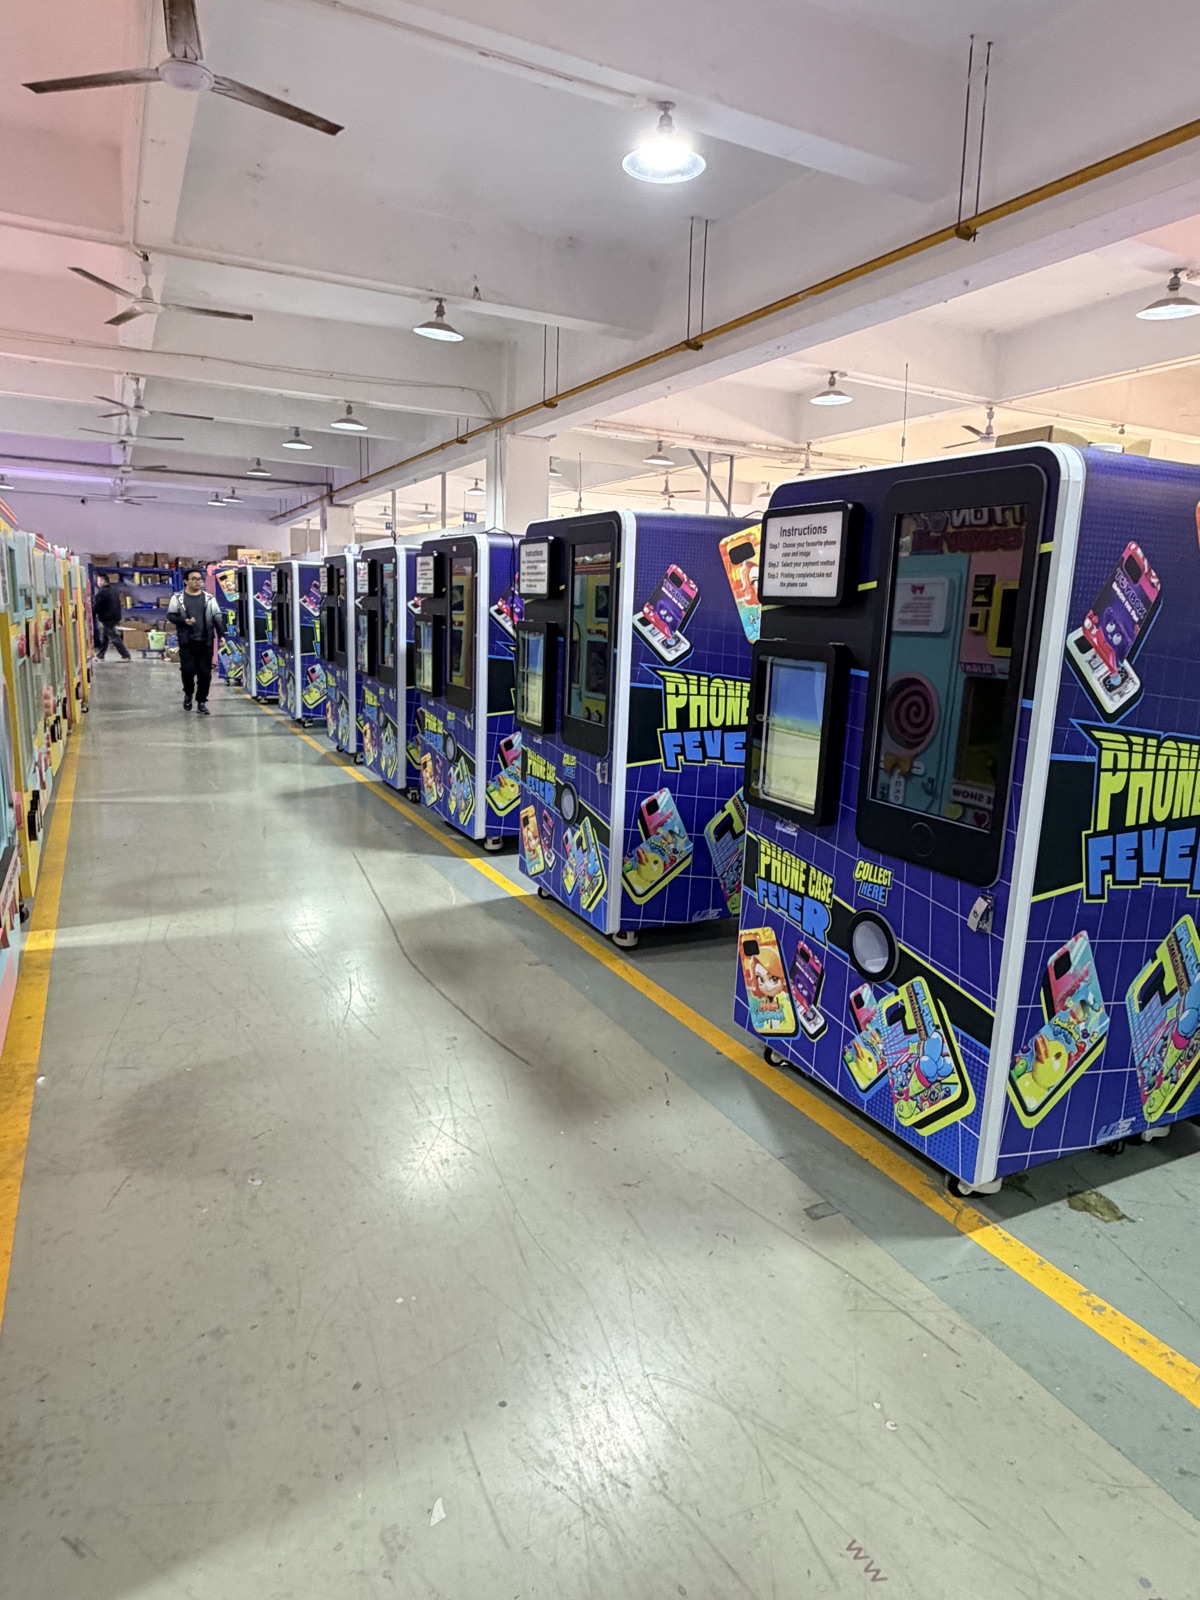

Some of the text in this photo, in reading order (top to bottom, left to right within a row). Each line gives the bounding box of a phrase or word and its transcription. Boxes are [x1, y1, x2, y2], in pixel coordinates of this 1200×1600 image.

[780, 524, 828, 537] Instructions
[769, 542, 780, 550] Step.1
[797, 541, 805, 549] your
[824, 539, 837, 548] phone
[799, 550, 811, 558] image
[768, 561, 779, 569] Step.2
[781, 560, 793, 568] Select
[794, 561, 802, 569] your
[802, 560, 820, 568] payment
[780, 572, 795, 580] Printing
[656, 670, 751, 730] PHONE
[662, 729, 747, 768] FEVE
[756, 834, 834, 903] PHONE CASE
[1088, 827, 1200, 895] FEVE
[854, 860, 893, 887] COLLECT
[860, 882, 887, 903] HERE
[757, 878, 830, 943] FEVER
